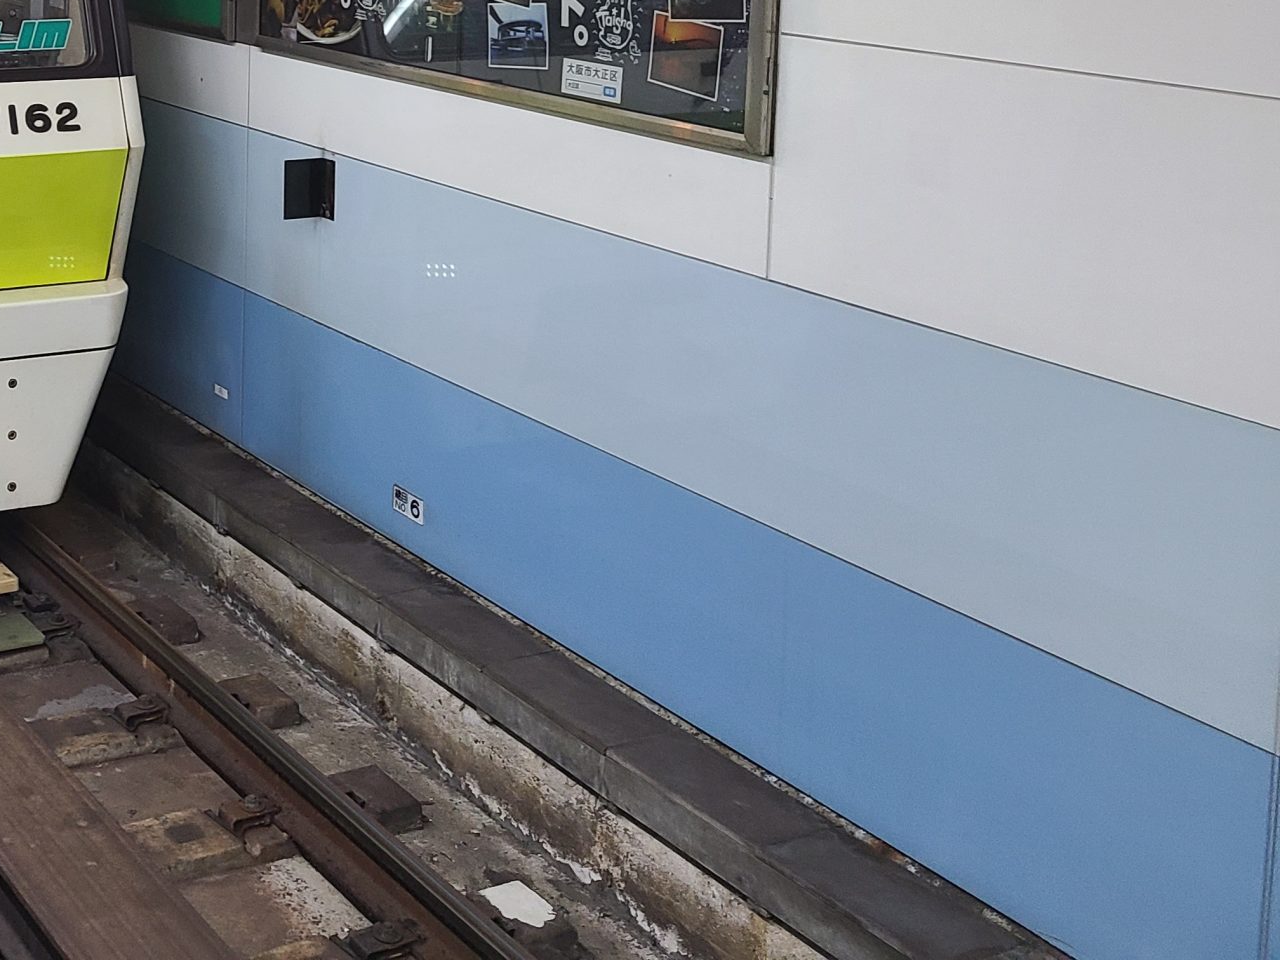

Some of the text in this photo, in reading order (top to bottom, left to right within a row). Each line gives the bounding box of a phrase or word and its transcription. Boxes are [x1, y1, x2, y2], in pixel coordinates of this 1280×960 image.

[595, 7, 633, 34] Taisho
[566, 62, 619, 82] 大阪市大正区
[410, 499, 420, 519] 6
